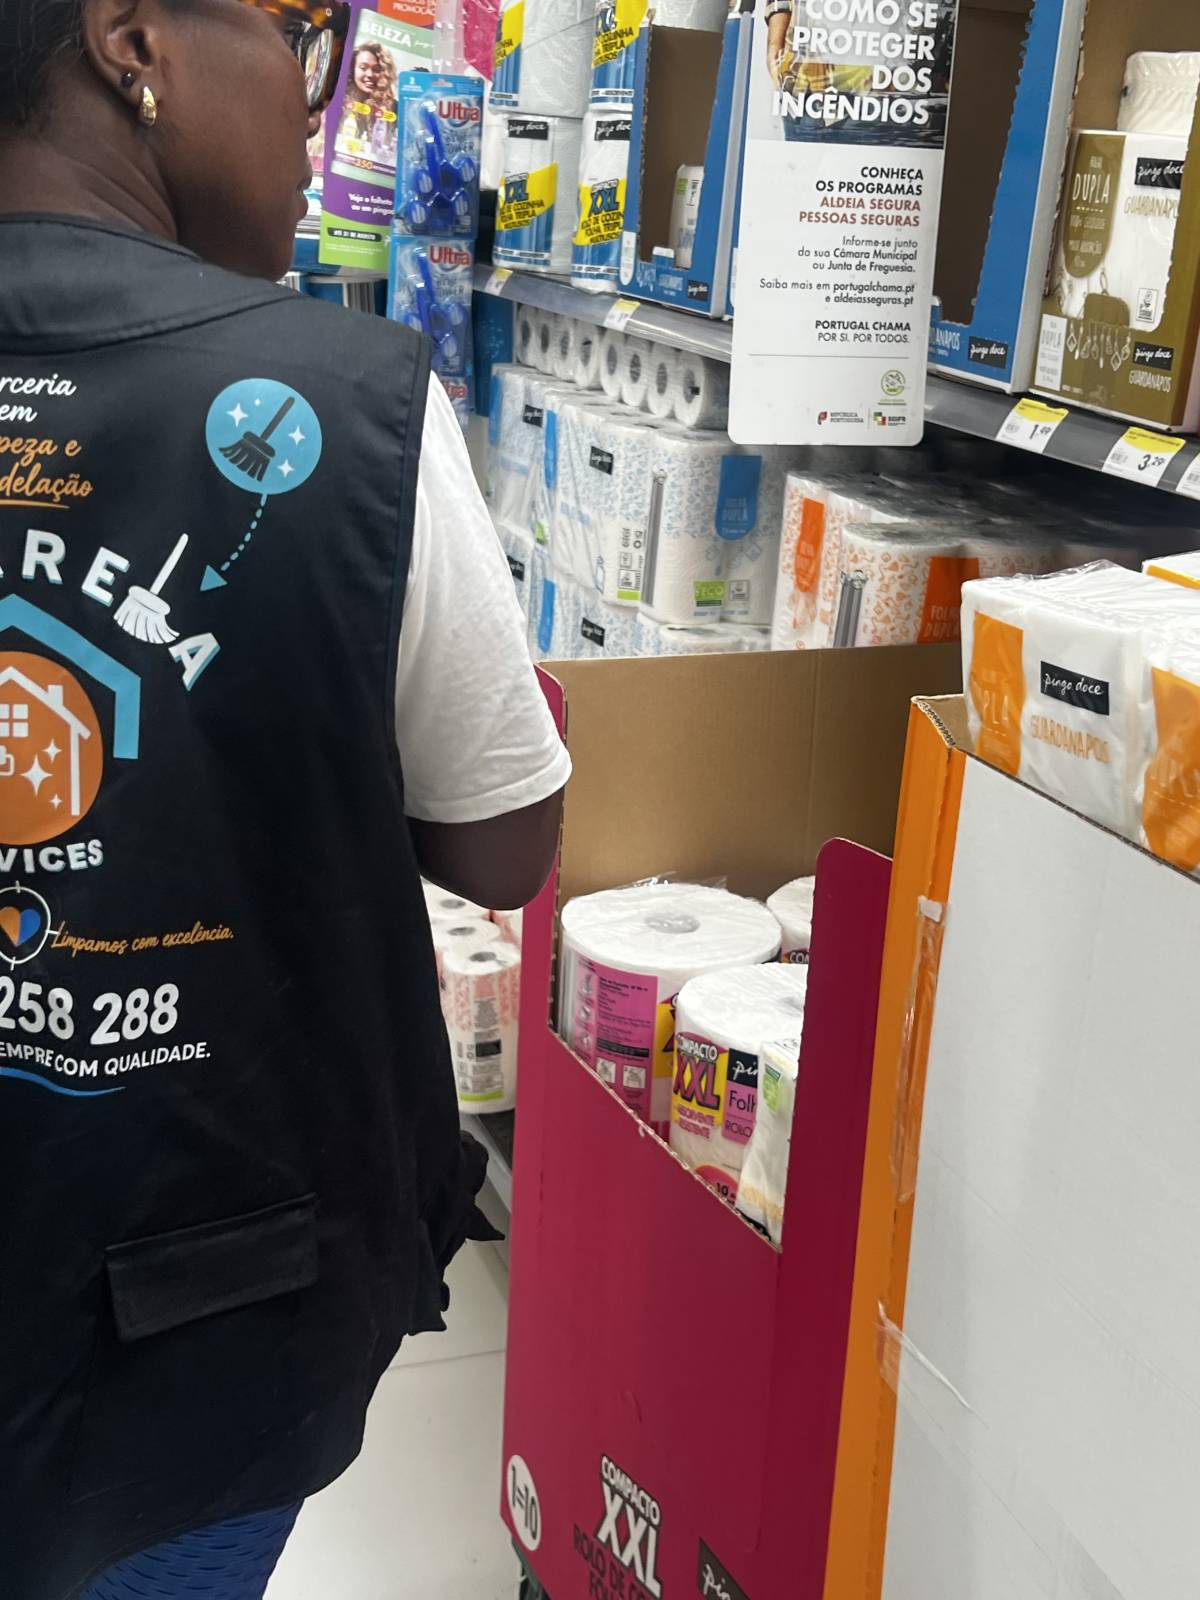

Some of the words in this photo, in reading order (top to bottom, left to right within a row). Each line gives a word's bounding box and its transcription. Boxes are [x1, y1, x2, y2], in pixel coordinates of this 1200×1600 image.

[805, 0, 899, 26] COMO
[908, 1, 938, 28] SE
[360, 22, 411, 47] BELEZA
[793, 26, 935, 60] PROTEGER
[872, 65, 932, 93] DOS
[438, 100, 481, 121] Ultra
[772, 87, 929, 125] INCÊNDIOS
[861, 166, 924, 182] CONHEÇA
[1137, 166, 1162, 182] pingo
[816, 180, 834, 192] OS
[839, 181, 923, 196] PROGRAMAS
[1072, 173, 1111, 204] DUPLA
[820, 196, 865, 209] ALDEIA
[870, 198, 921, 211] SEGURA
[800, 211, 856, 224] PESSOAS
[861, 213, 920, 227] SEGURAS
[842, 235, 891, 247] Informe-se
[894, 237, 918, 251] junto
[429, 244, 471, 265] Ultra
[833, 247, 870, 259] Câmara
[873, 250, 918, 262] Municipal
[812, 262, 825, 270] ou
[827, 260, 852, 271] Junta
[855, 261, 867, 271] de
[869, 261, 916, 274] Freguesia.
[760, 278, 788, 289] Saiba
[791, 280, 813, 289] mais
[816, 282, 830, 290] em
[833, 280, 915, 294] portugalchama.pt
[834, 293, 914, 307] aldeiasseguras.pt
[815, 320, 869, 331] PORTUGAL
[872, 321, 911, 331] CHAMA
[818, 333, 836, 342] POR
[853, 334, 872, 343] POR
[875, 334, 909, 344] TODOS.
[1129, 369, 1172, 393] GUARDANAPOS
[65, 440, 81, 456] e
[1044, 673, 1072, 695] pingo
[1075, 677, 1104, 695] doce
[1031, 714, 1110, 765] GUARDANAPOS
[52, 921, 128, 957] Limpamos
[132, 933, 159, 948] com
[163, 921, 234, 947] excelência.
[0, 976, 75, 1040] 258
[90, 983, 180, 1045] 288
[678, 1035, 718, 1060] COMPACTO
[55, 1054, 98, 1077] COM
[104, 1042, 211, 1075] QUALIDADE.
[673, 1053, 720, 1110] XXL
[726, 1120, 753, 1138] ROLO
[601, 1455, 661, 1526] COMPACTO
[597, 1482, 662, 1599] XXL
